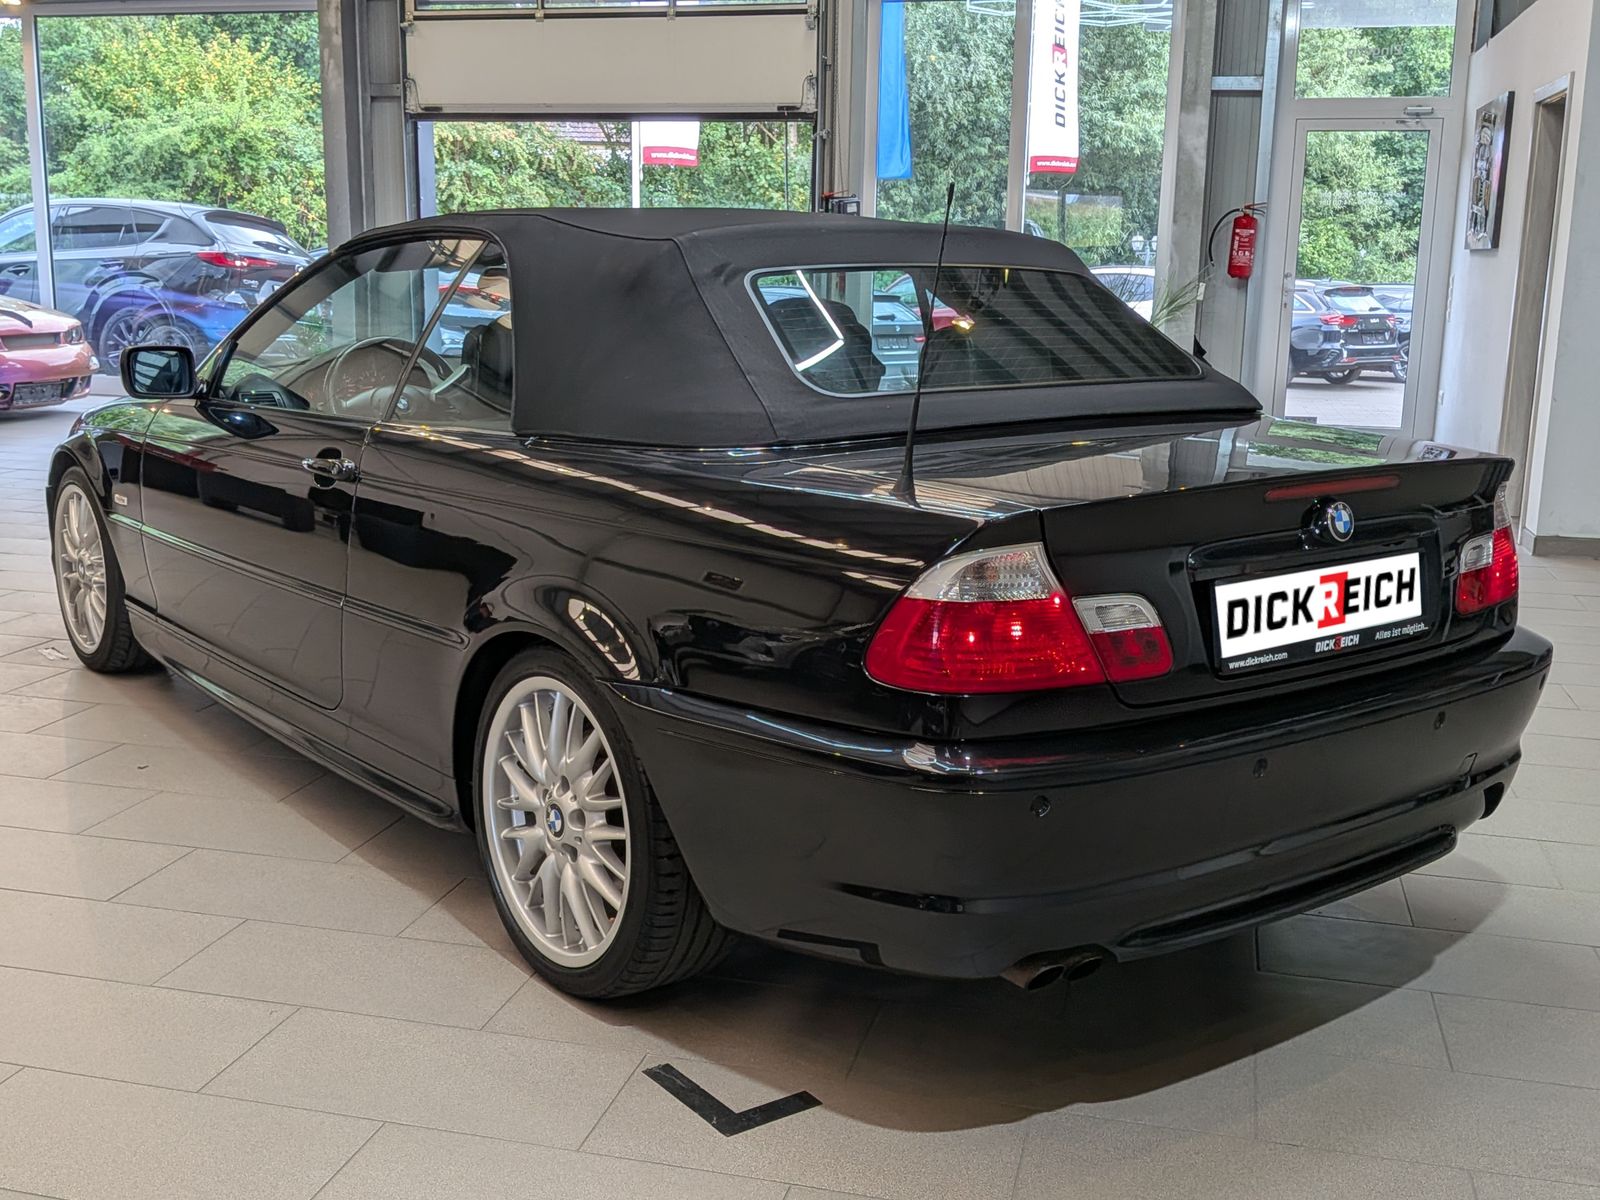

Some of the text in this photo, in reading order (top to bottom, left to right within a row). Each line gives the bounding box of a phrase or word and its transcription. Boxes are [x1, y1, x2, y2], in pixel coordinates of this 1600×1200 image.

[1226, 567, 1416, 640] DICKREICH
[1315, 633, 1360, 653] DICKREICH
[1375, 630, 1392, 641] Alles
[1392, 627, 1401, 638] ist
[1228, 652, 1288, 670] www.dickreich.com
